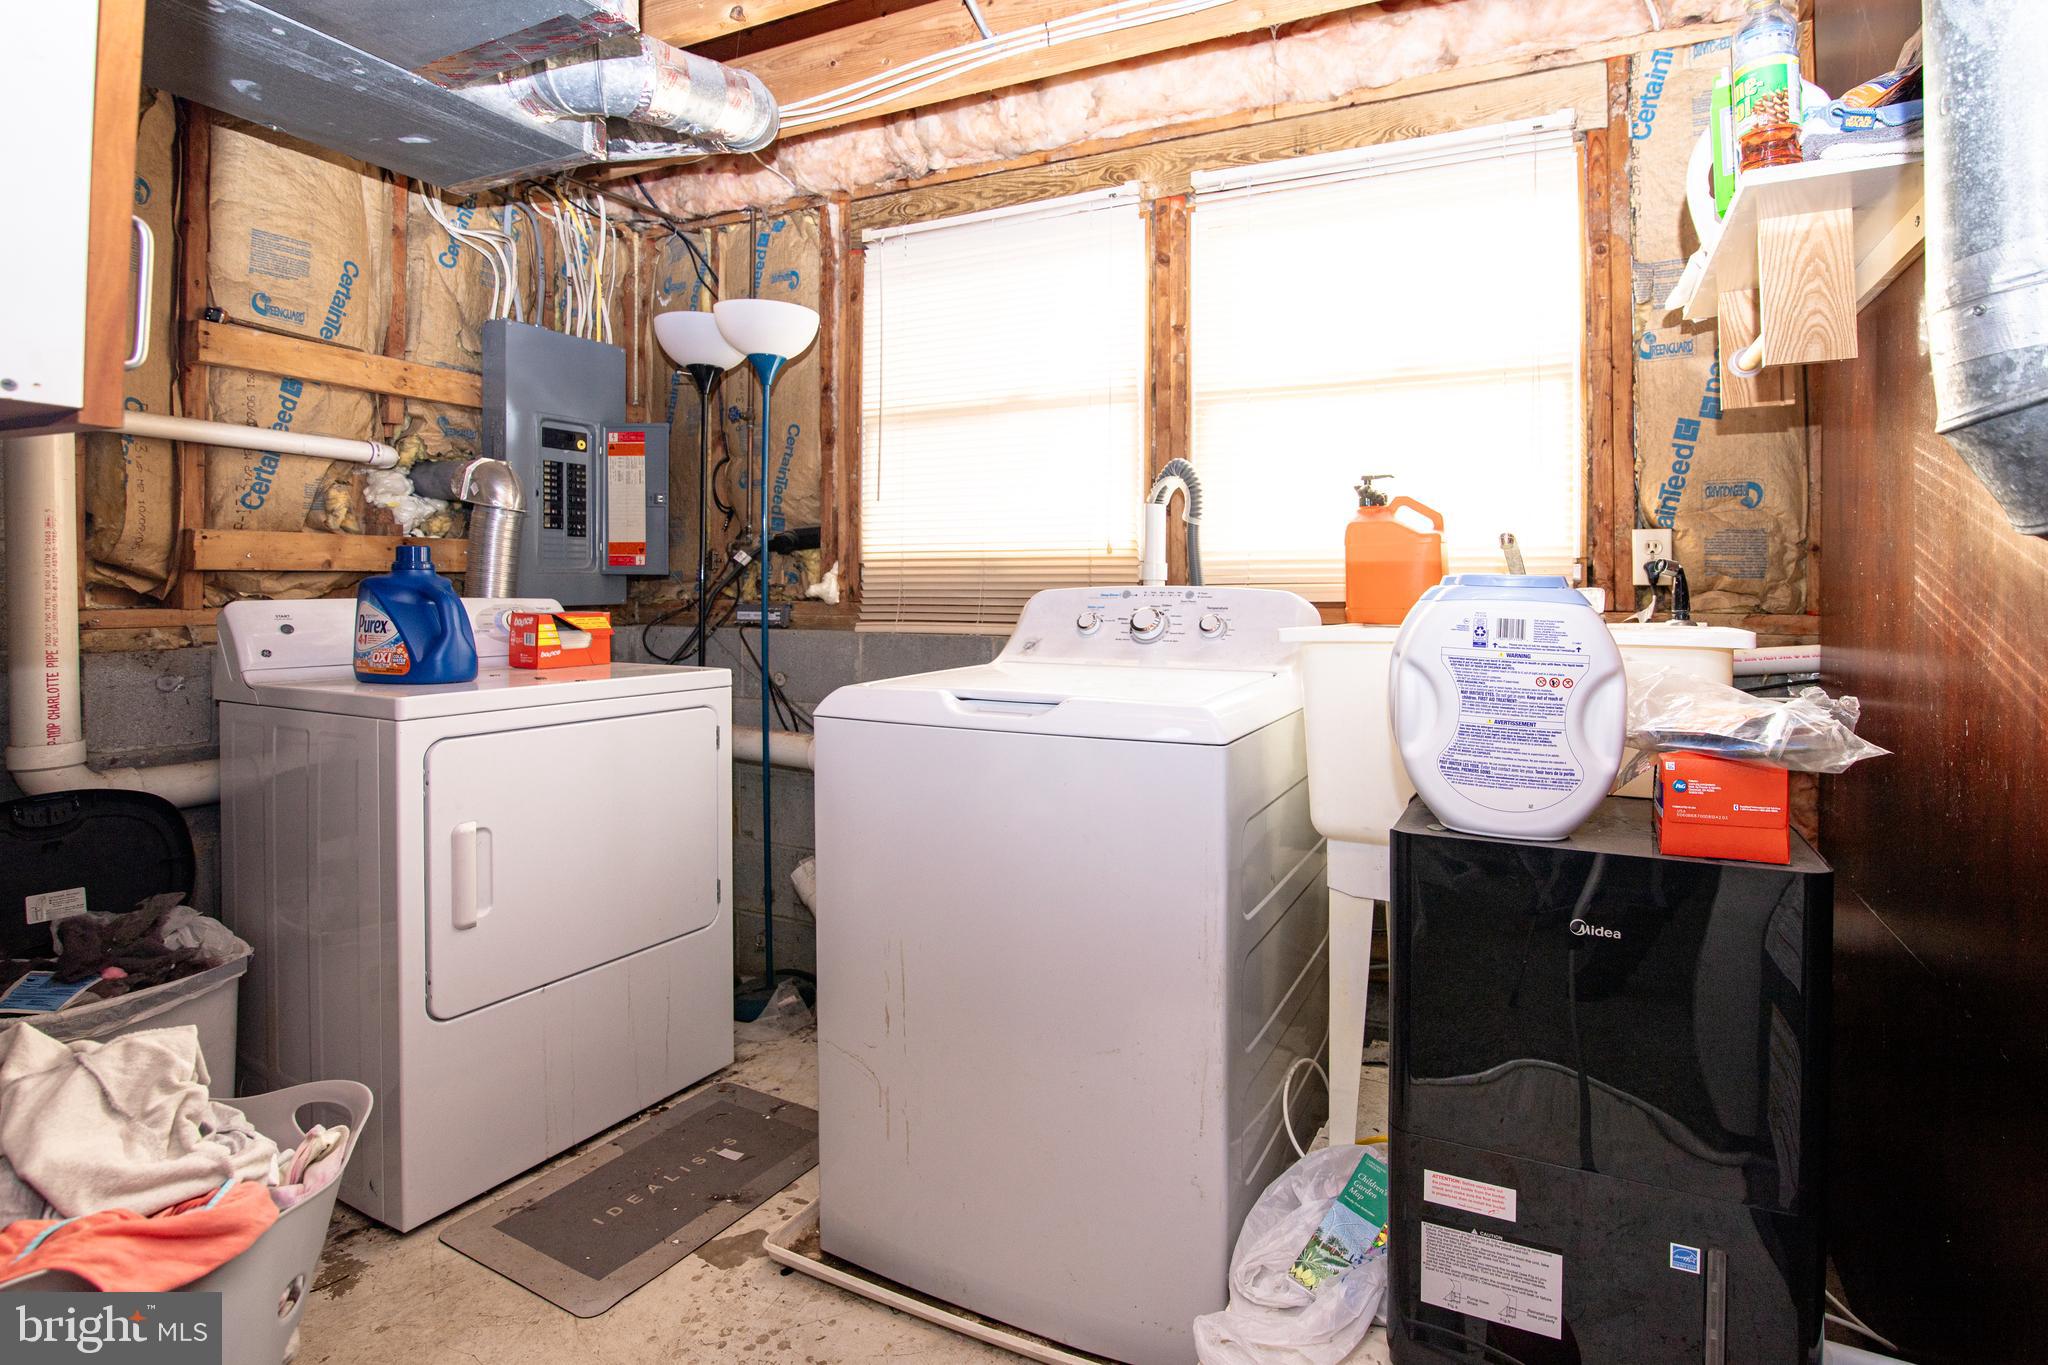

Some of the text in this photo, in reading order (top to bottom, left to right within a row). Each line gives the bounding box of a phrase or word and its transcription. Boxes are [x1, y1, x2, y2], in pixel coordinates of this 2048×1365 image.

[1638, 332, 1694, 360] GREENGUARD
[771, 423, 800, 515] CertainTeed
[1704, 481, 1764, 509] GREENGUARD
[359, 614, 388, 634] Purex
[46, 650, 58, 668] PIPE
[373, 652, 392, 664] OXI
[540, 650, 562, 658] bounce
[47, 672, 60, 720] CHARLOTTE
[1494, 720, 1536, 728] AVERTISSEMENT
[1575, 921, 1621, 939] Midea
[592, 1138, 736, 1224] IDEALISTS
[1432, 1173, 1460, 1184] ATTENTION:
[1349, 1186, 1364, 1200] Map
[1354, 1180, 1377, 1199] Garden
[1480, 1231, 1503, 1240] CAUTION
